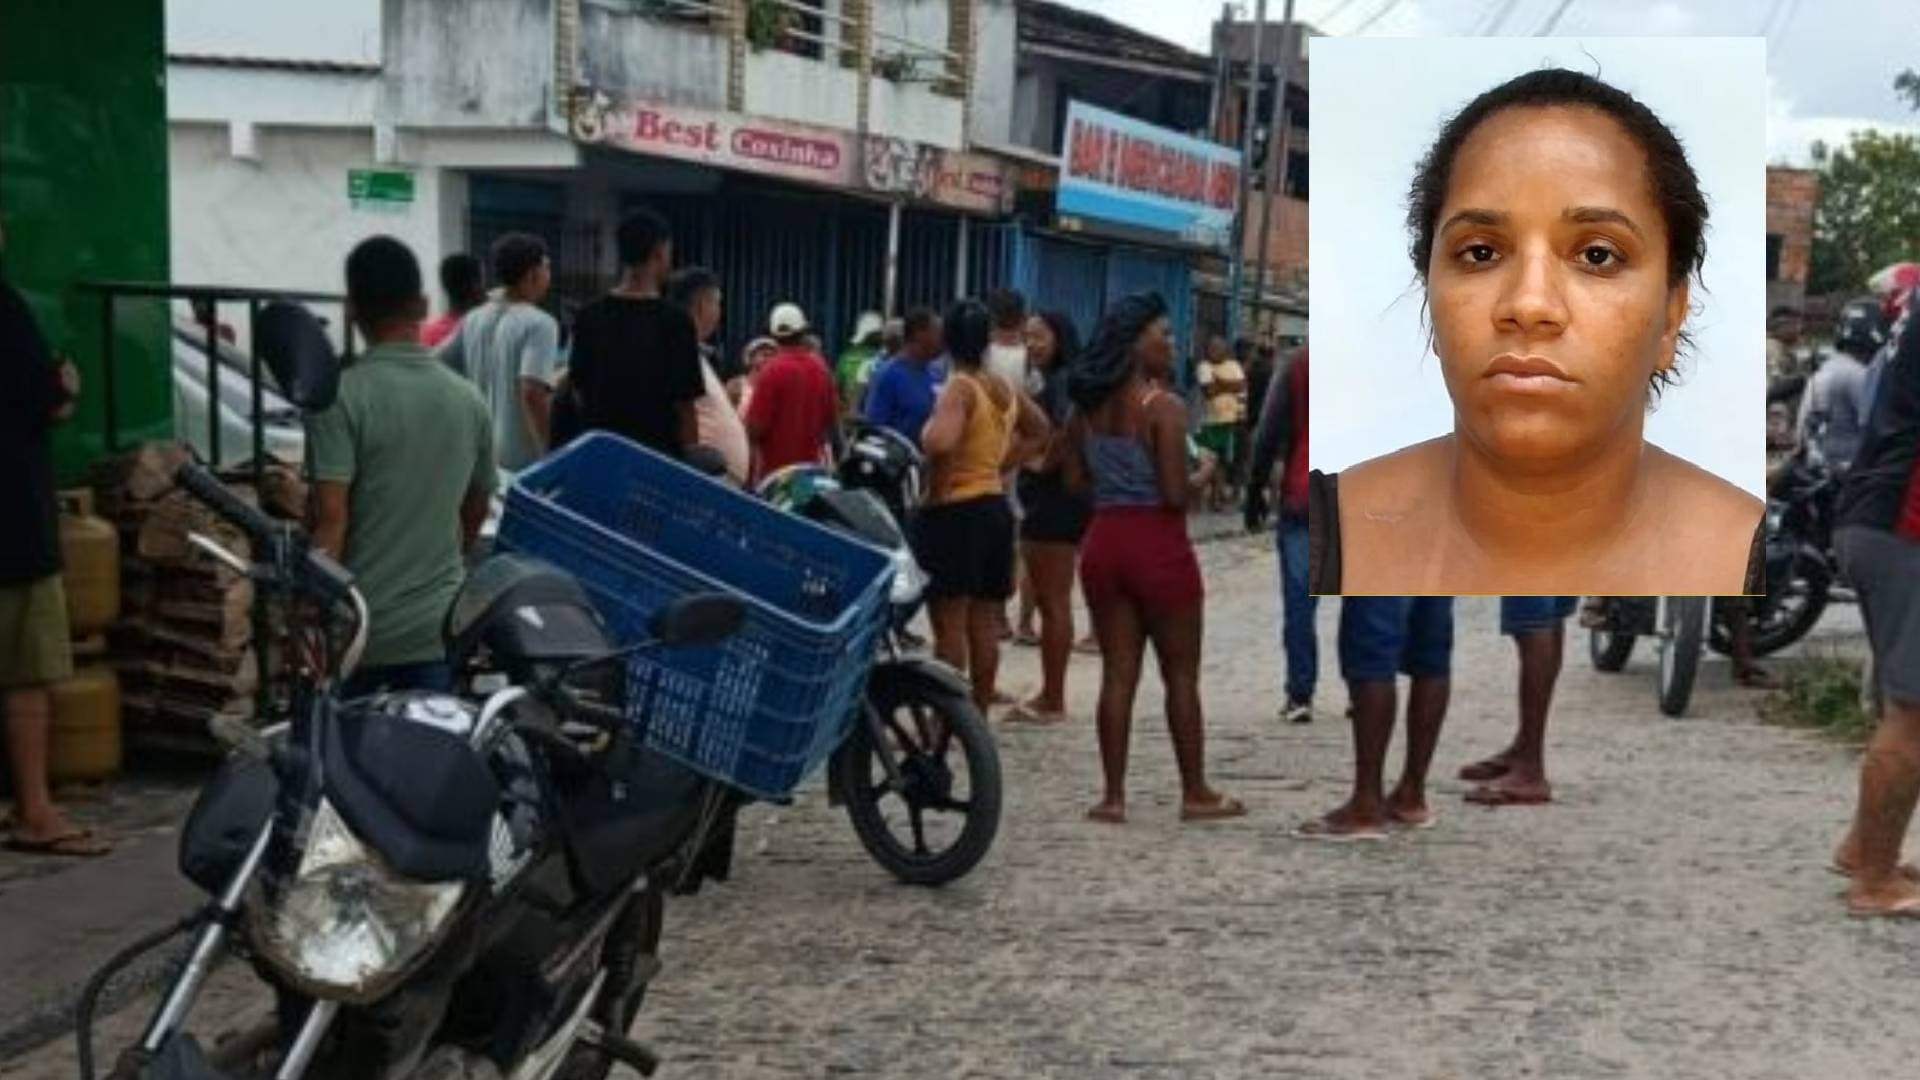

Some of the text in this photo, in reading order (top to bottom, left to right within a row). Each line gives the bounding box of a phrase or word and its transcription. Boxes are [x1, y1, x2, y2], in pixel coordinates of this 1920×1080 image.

[634, 110, 838, 169] Best Coxinha
[1070, 117, 1105, 179] BAR
